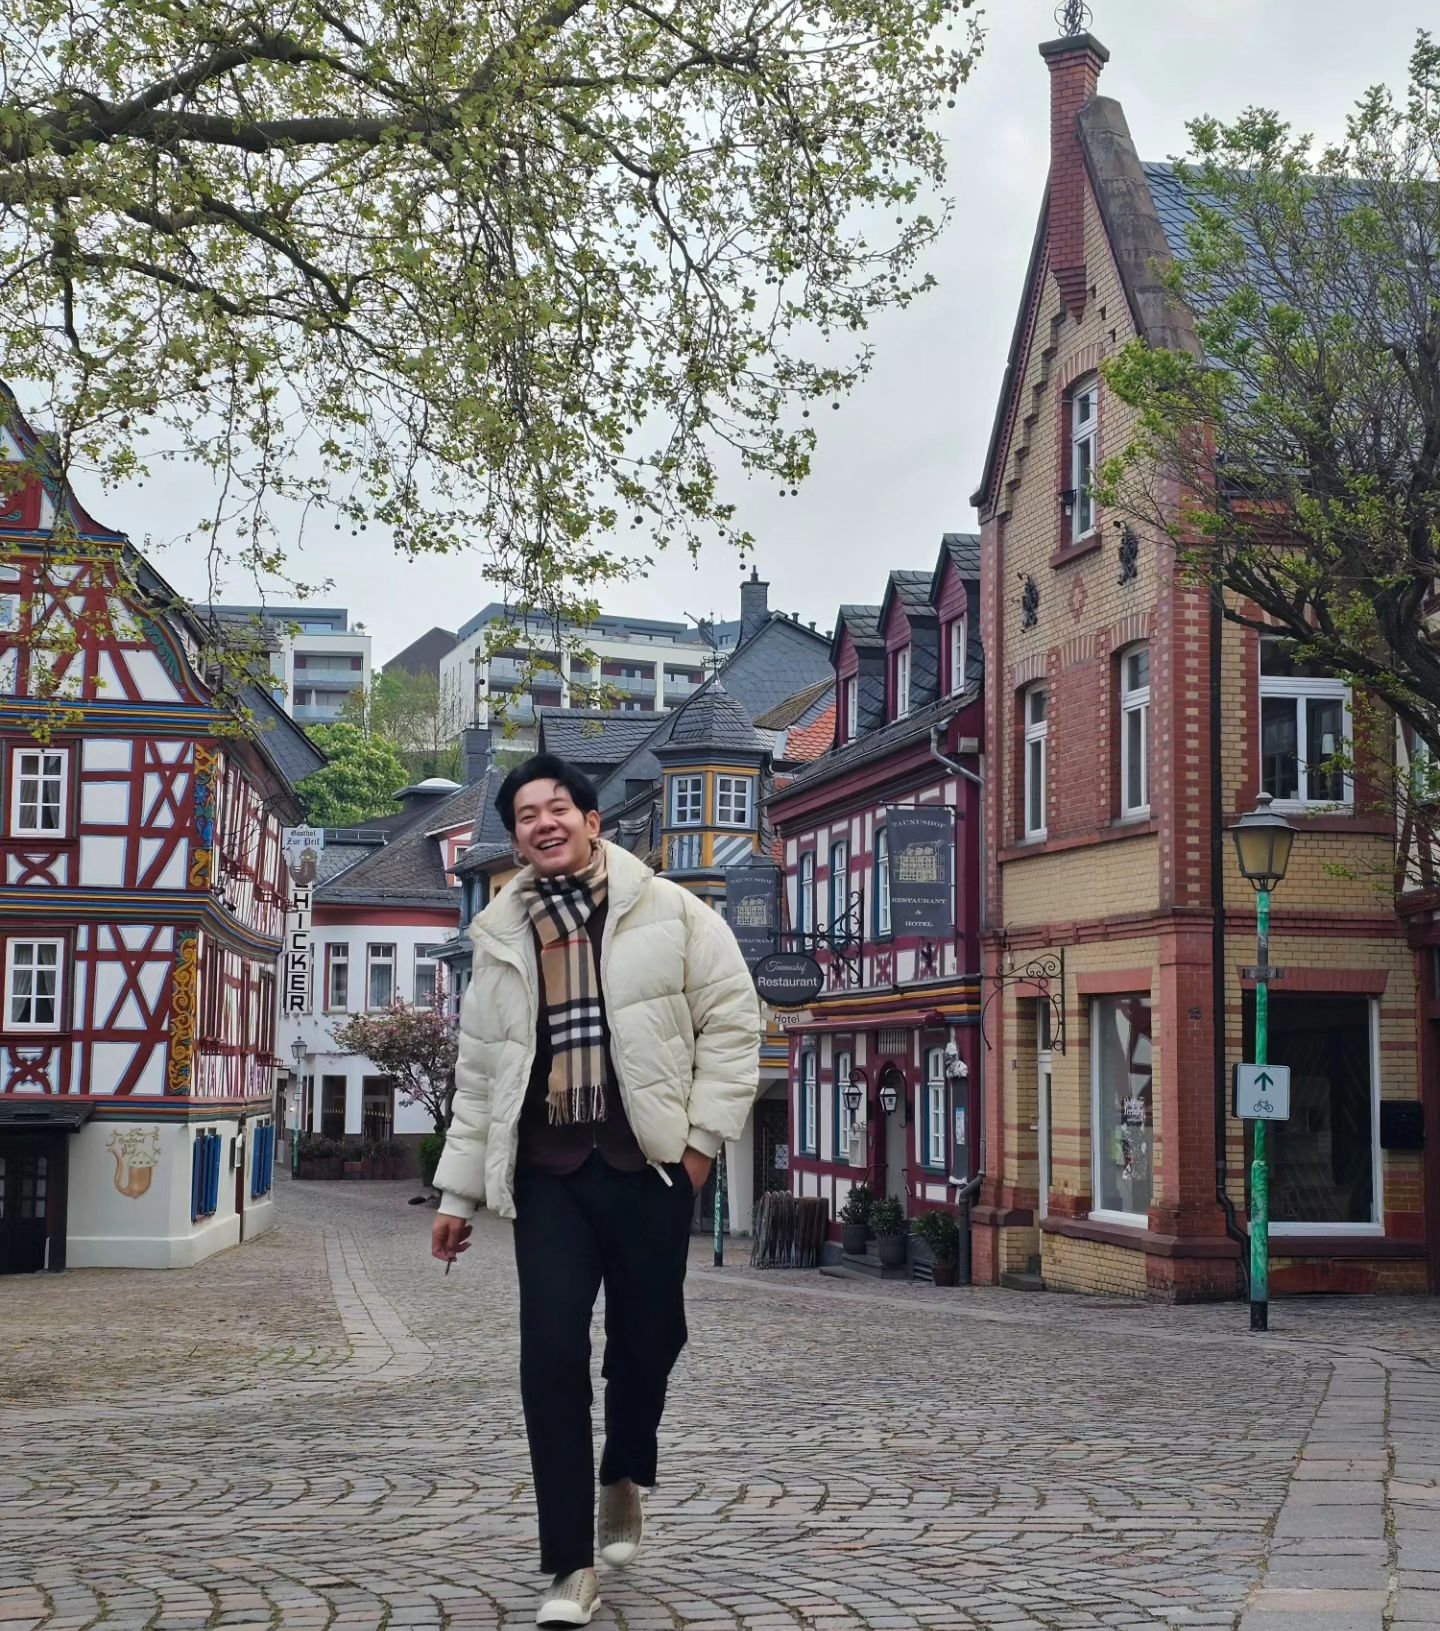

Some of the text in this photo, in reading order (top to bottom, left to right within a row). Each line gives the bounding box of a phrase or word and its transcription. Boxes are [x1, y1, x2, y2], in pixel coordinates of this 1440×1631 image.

[892, 896, 946, 905] RESTAURANT
[905, 920, 933, 928] HOTEL
[289, 881, 309, 1012] HICKER
[757, 976, 818, 987] Restaurant
[773, 1013, 801, 1024] Hotel
